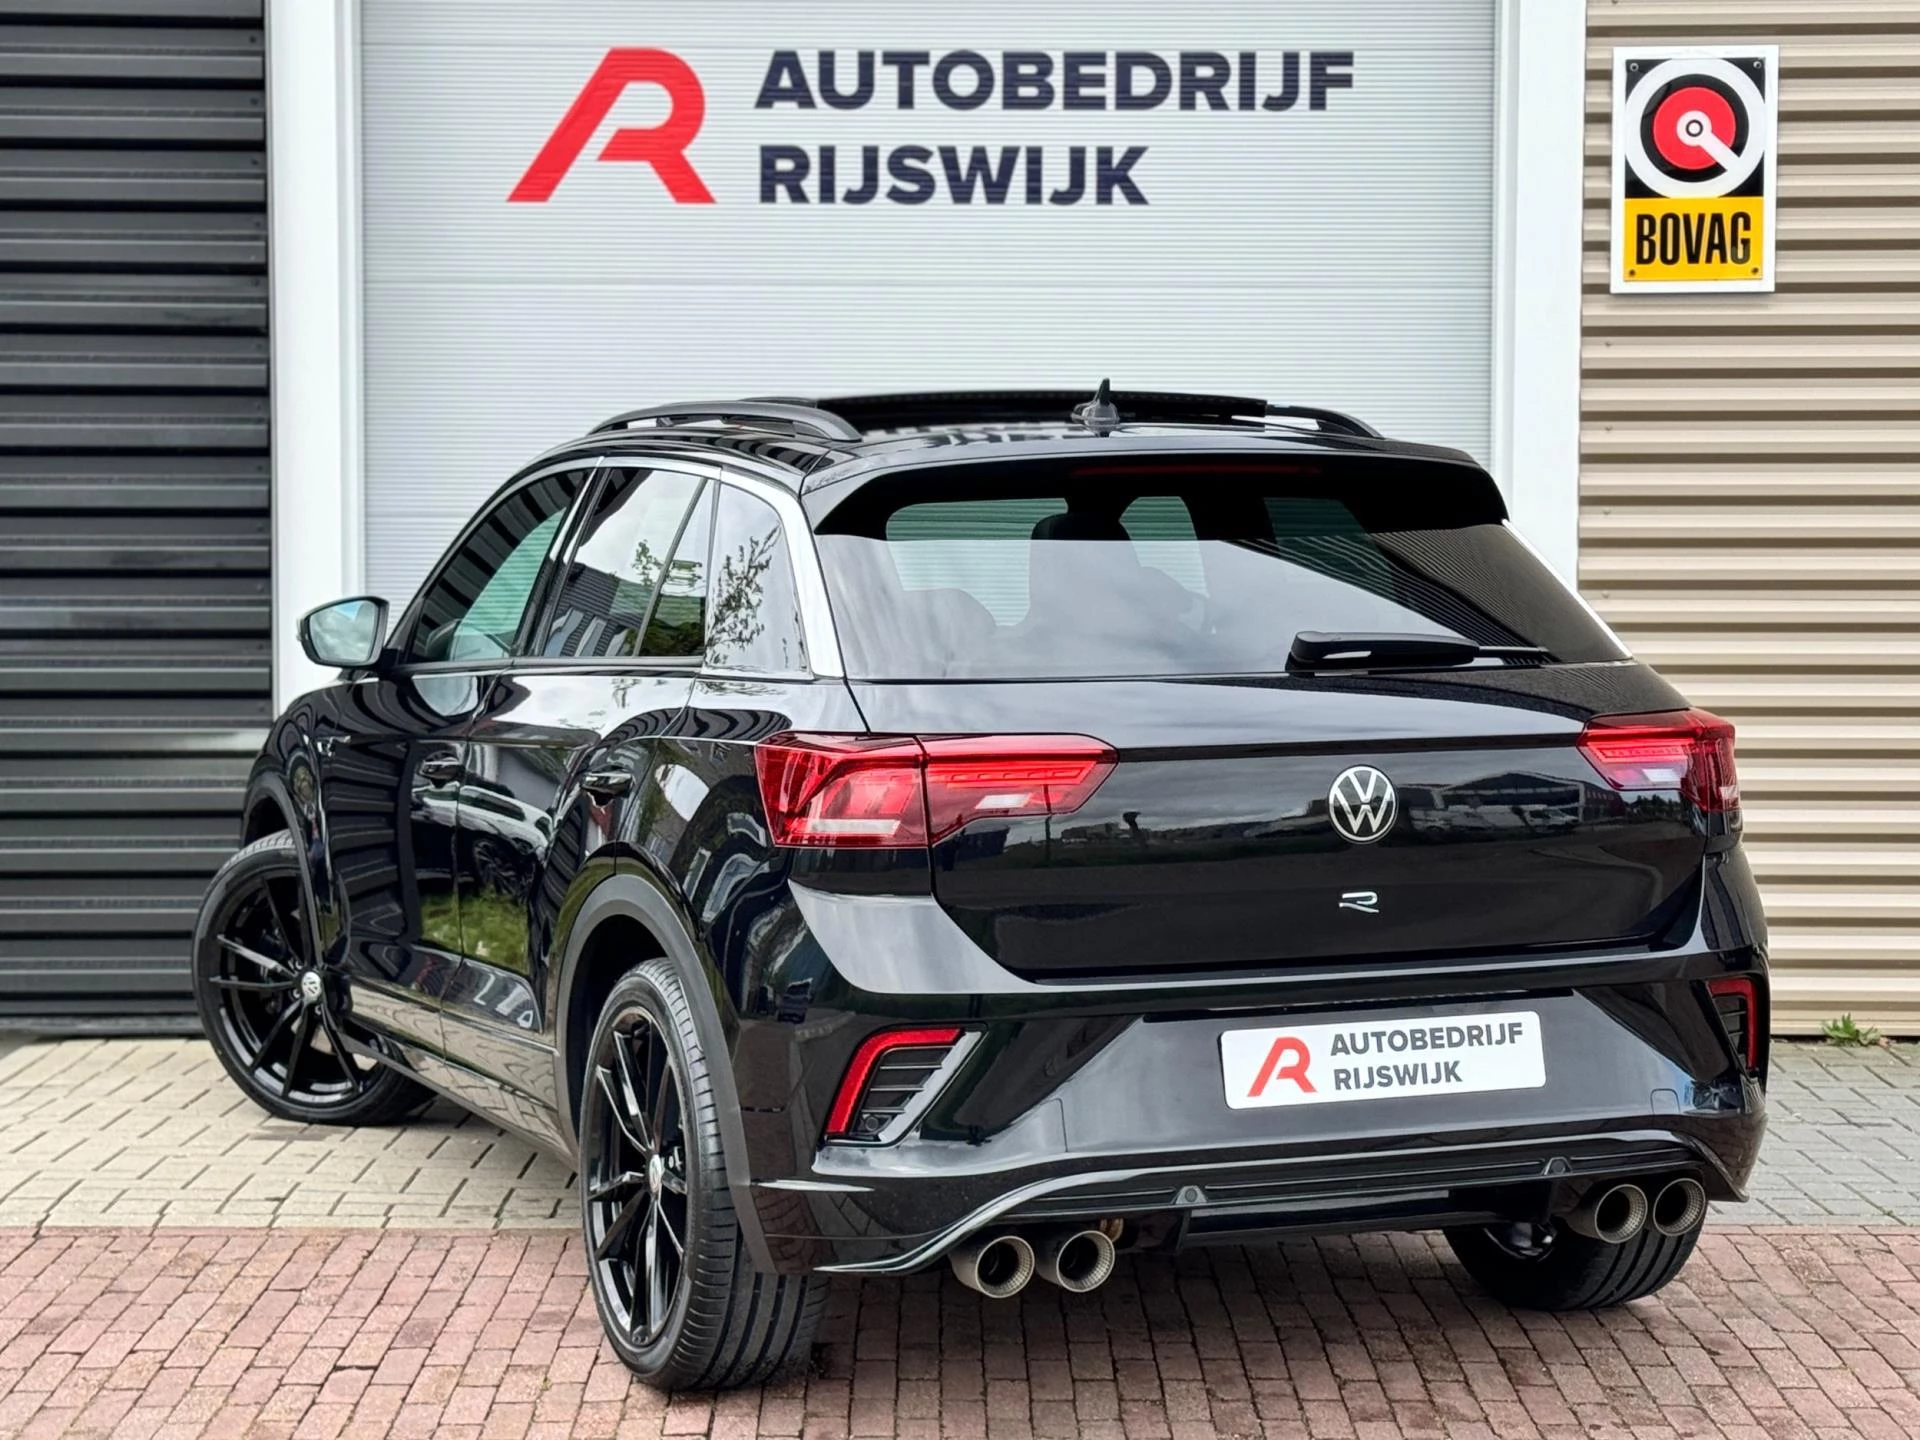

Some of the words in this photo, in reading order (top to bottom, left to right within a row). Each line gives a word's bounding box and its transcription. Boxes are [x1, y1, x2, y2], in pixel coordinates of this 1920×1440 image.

[755, 50, 1354, 112] AUTOBEDRIJF
[760, 145, 1149, 206] RIJSWIJK
[1636, 211, 1751, 266] BOVAG
[1330, 1022, 1523, 1057] AUTOBEDRIJF
[1333, 1060, 1463, 1091] RIJSWIJK
